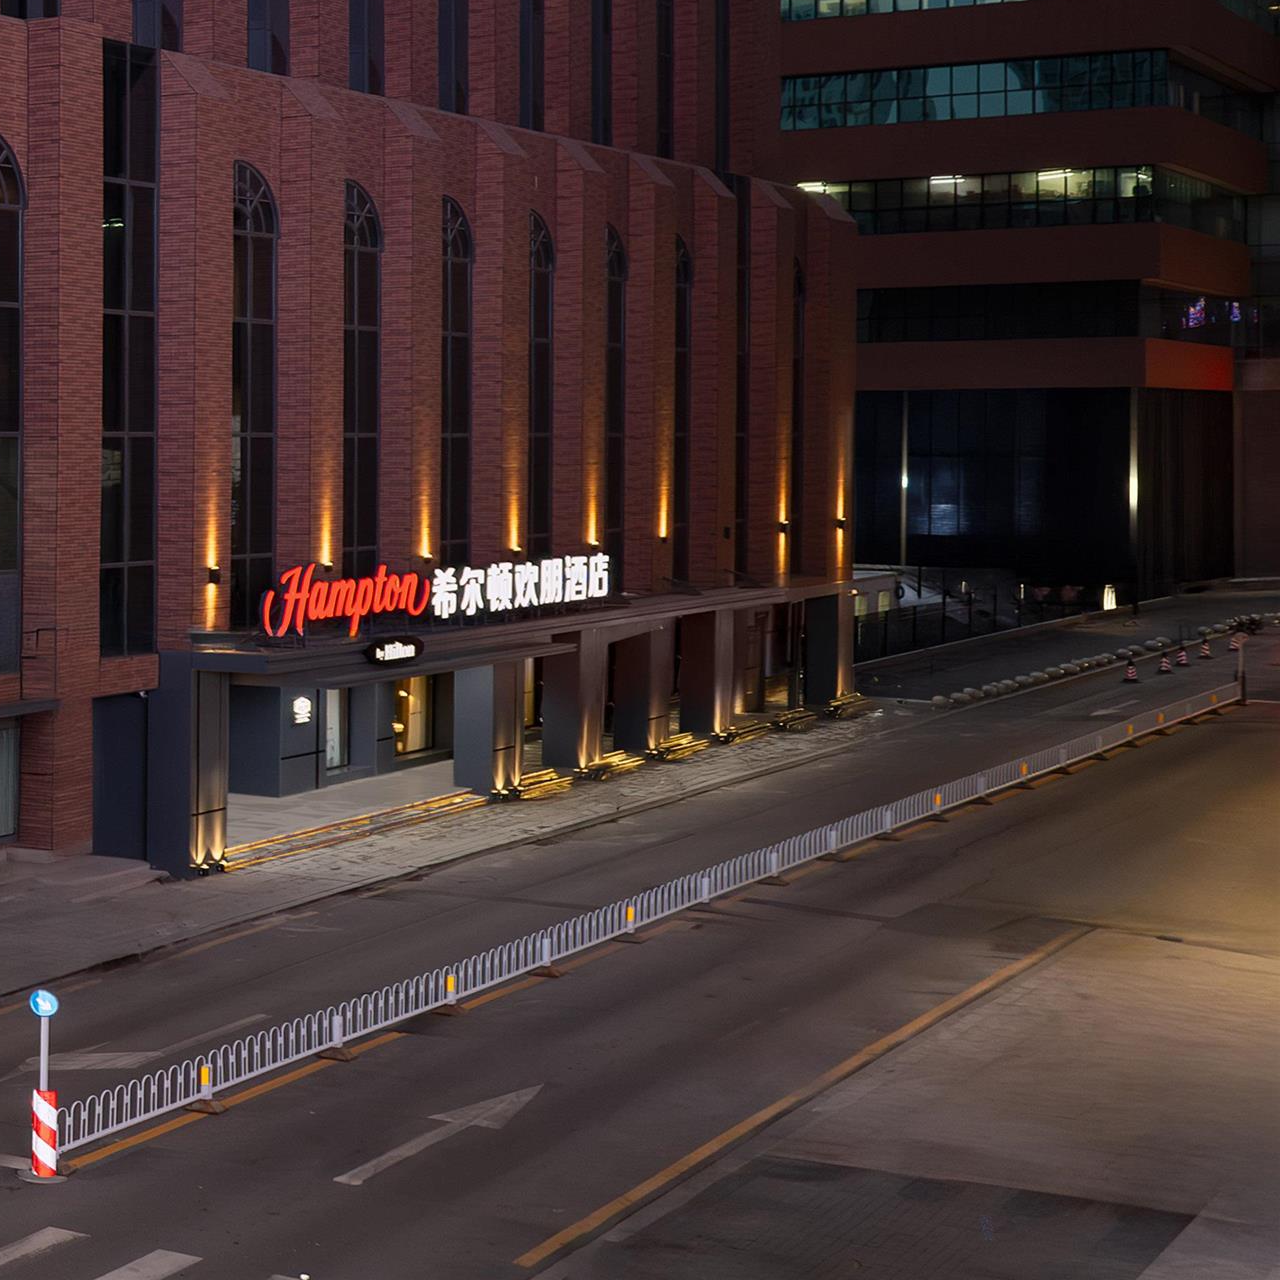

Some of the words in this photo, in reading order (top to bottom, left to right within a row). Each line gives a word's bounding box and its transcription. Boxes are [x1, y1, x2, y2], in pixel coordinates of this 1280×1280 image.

[263, 563, 431, 638] Hampton
[431, 552, 610, 619] 希尔顿欢朋酒店
